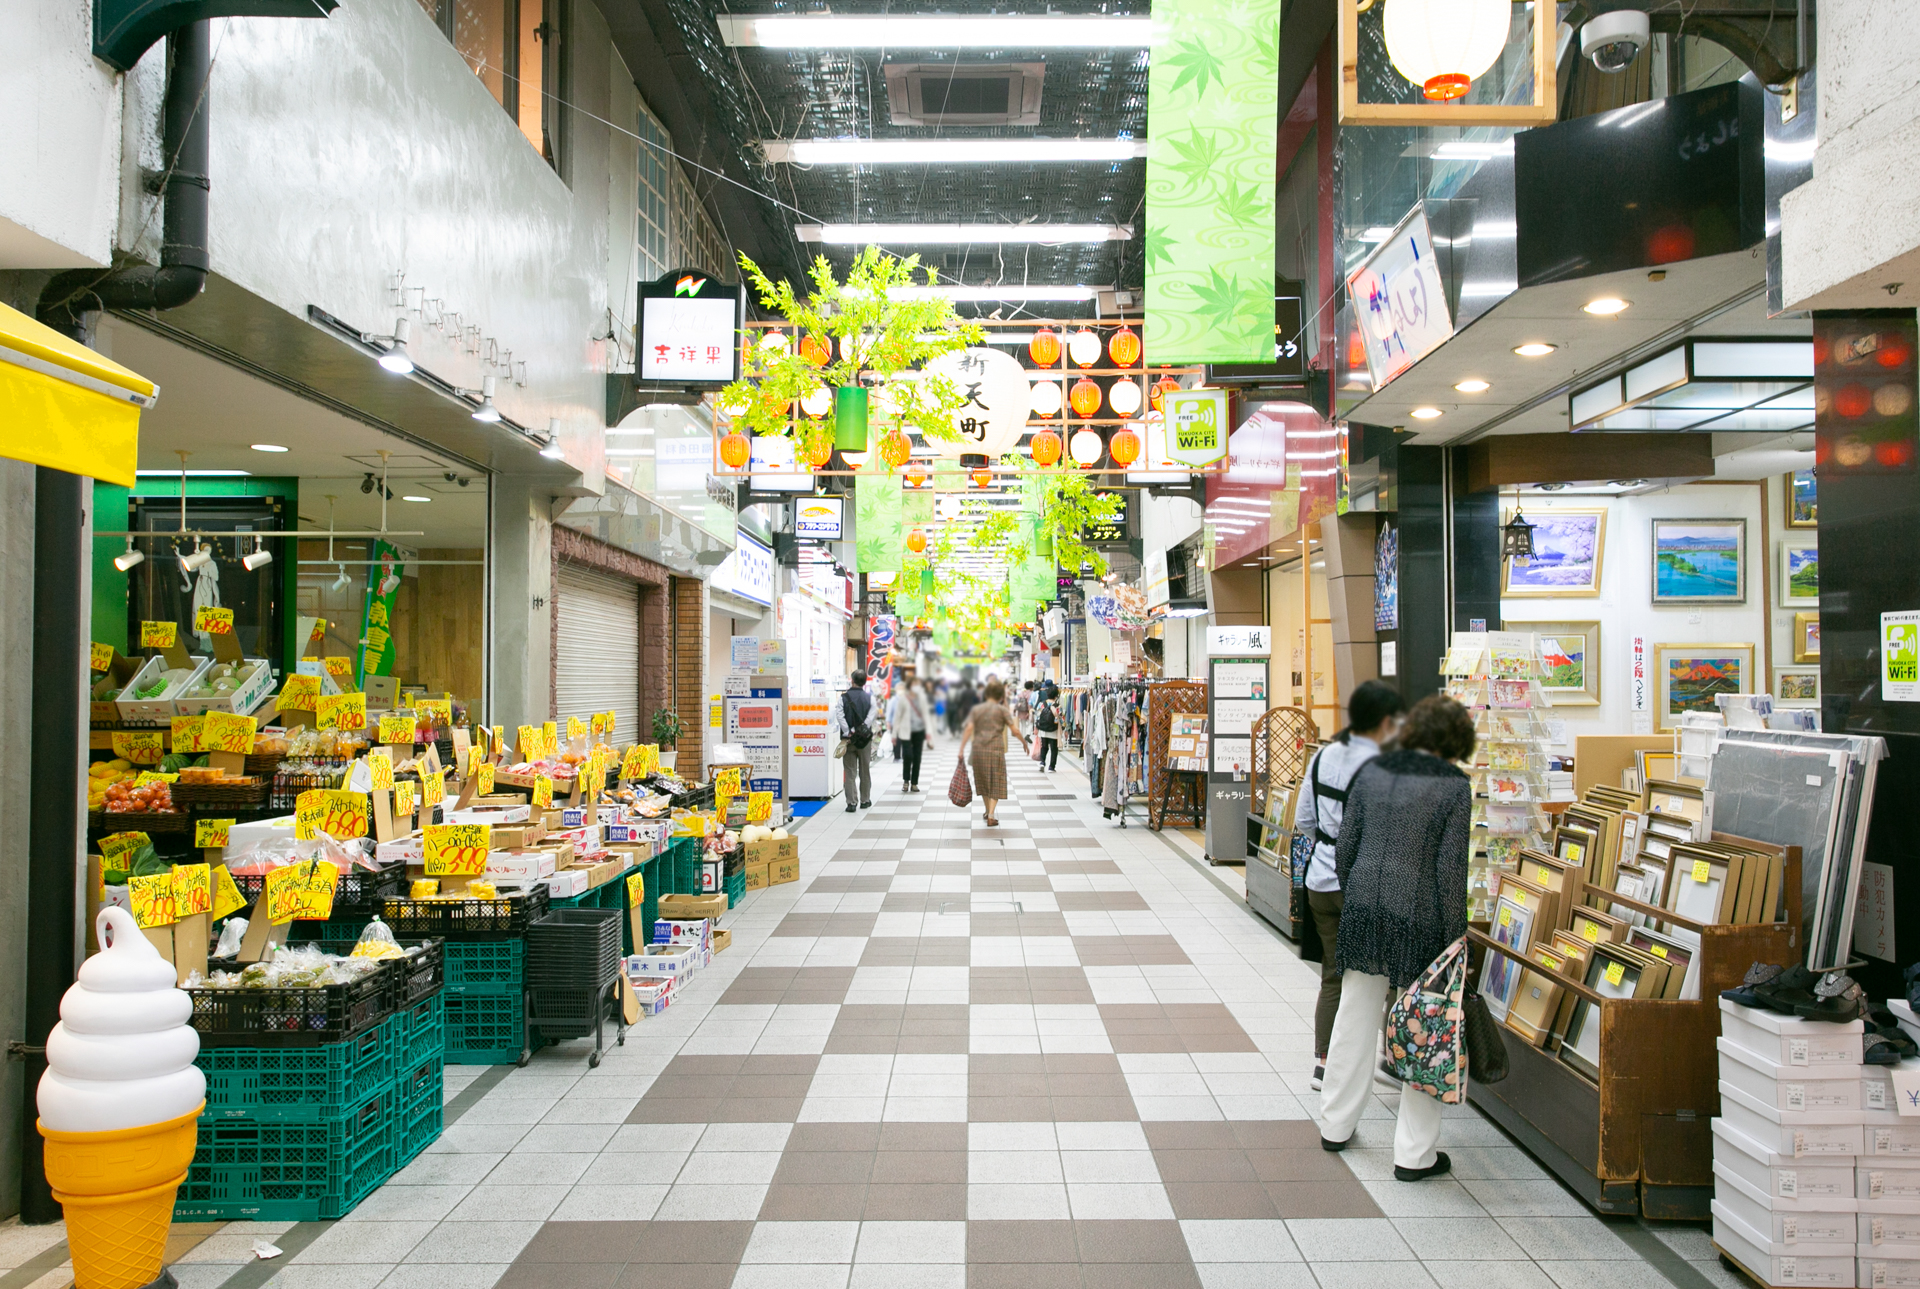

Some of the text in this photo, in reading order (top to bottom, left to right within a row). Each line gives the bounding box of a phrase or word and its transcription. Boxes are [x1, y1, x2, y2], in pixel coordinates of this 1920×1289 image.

[654, 344, 721, 364] 吉祥果
[957, 352, 990, 442] 新天町
[1179, 436, 1215, 447] Wi-Fi
[1218, 631, 1262, 648] ギャラリー風
[867, 619, 894, 680] うどん
[1889, 666, 1916, 679] Wi-Fi
[324, 810, 366, 838] 680
[638, 830, 658, 840] いちご
[439, 846, 488, 875] 398
[1874, 870, 1886, 957] 防犯カメラ
[682, 926, 702, 937] いちご
[631, 963, 676, 971] 黒木 巨峰
